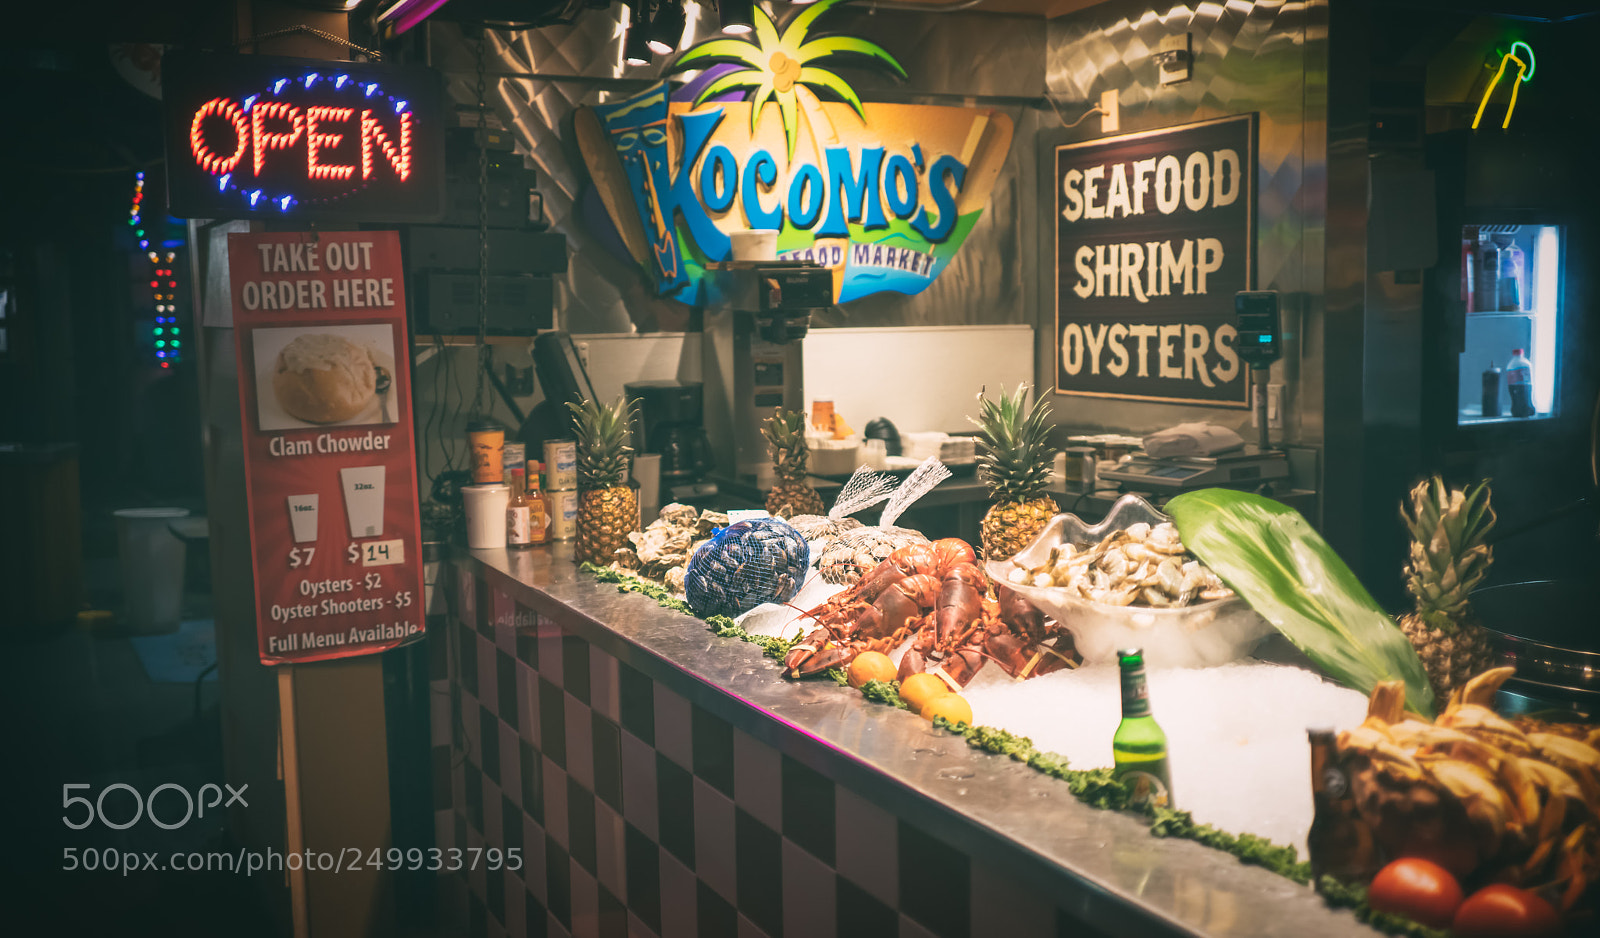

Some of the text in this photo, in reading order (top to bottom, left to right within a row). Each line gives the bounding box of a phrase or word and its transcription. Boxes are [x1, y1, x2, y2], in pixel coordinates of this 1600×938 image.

[190, 97, 412, 182] OPEN
[1062, 148, 1241, 222] SEAFOOD
[258, 242, 373, 273] TAKE OUT
[852, 241, 936, 277] MARKET
[1073, 237, 1225, 303] SHRIMP
[243, 278, 395, 310] ORDER HERE
[1062, 322, 1239, 388] OYSTERS
[269, 431, 391, 457] Clam Chowder
[288, 547, 316, 568] $7
[300, 576, 353, 599] Oysters
[365, 572, 382, 591] $2
[271, 602, 317, 624] Oyster
[321, 596, 383, 615] Shooters
[395, 591, 412, 609] $5
[269, 635, 298, 653] Full
[302, 631, 345, 650] Menu
